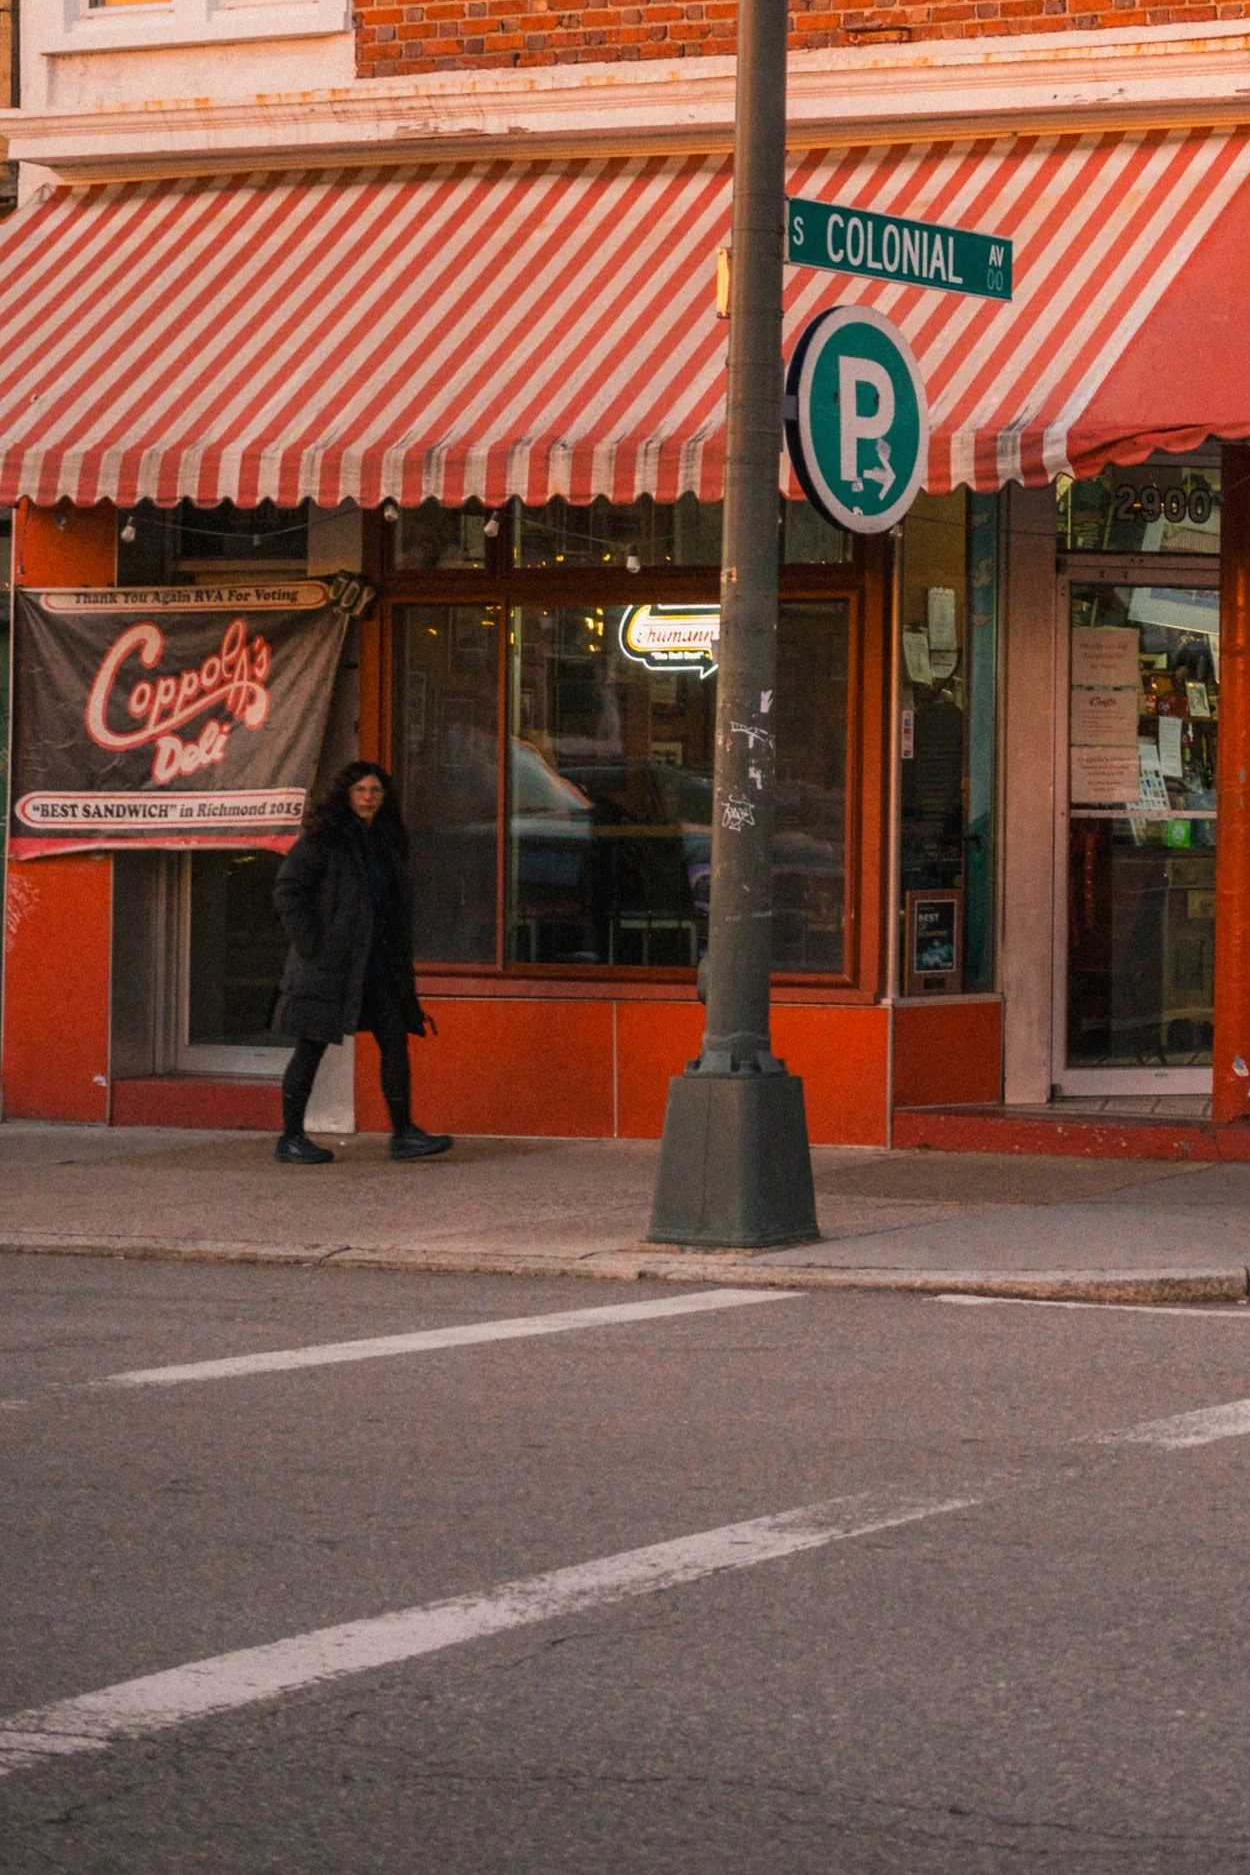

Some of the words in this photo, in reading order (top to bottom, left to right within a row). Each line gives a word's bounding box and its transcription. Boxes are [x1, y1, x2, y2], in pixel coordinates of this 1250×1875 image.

[792, 215, 804, 246] S
[827, 213, 963, 284] COLONIAL
[988, 244, 1005, 267] AV
[838, 355, 896, 482] P
[1115, 484, 1211, 523] 2900
[74, 592, 117, 604] Thank
[121, 592, 147, 604] You
[153, 590, 190, 605] Again
[194, 589, 223, 602] RVA
[227, 589, 249, 602] For
[255, 588, 299, 602] Voting
[151, 717, 231, 785] Deli
[32, 804, 80, 818] “BEST
[81, 803, 177, 819] SANDWICH”
[180, 804, 194, 817] in
[197, 801, 266, 817] Richmond
[268, 801, 303, 816] 2015
